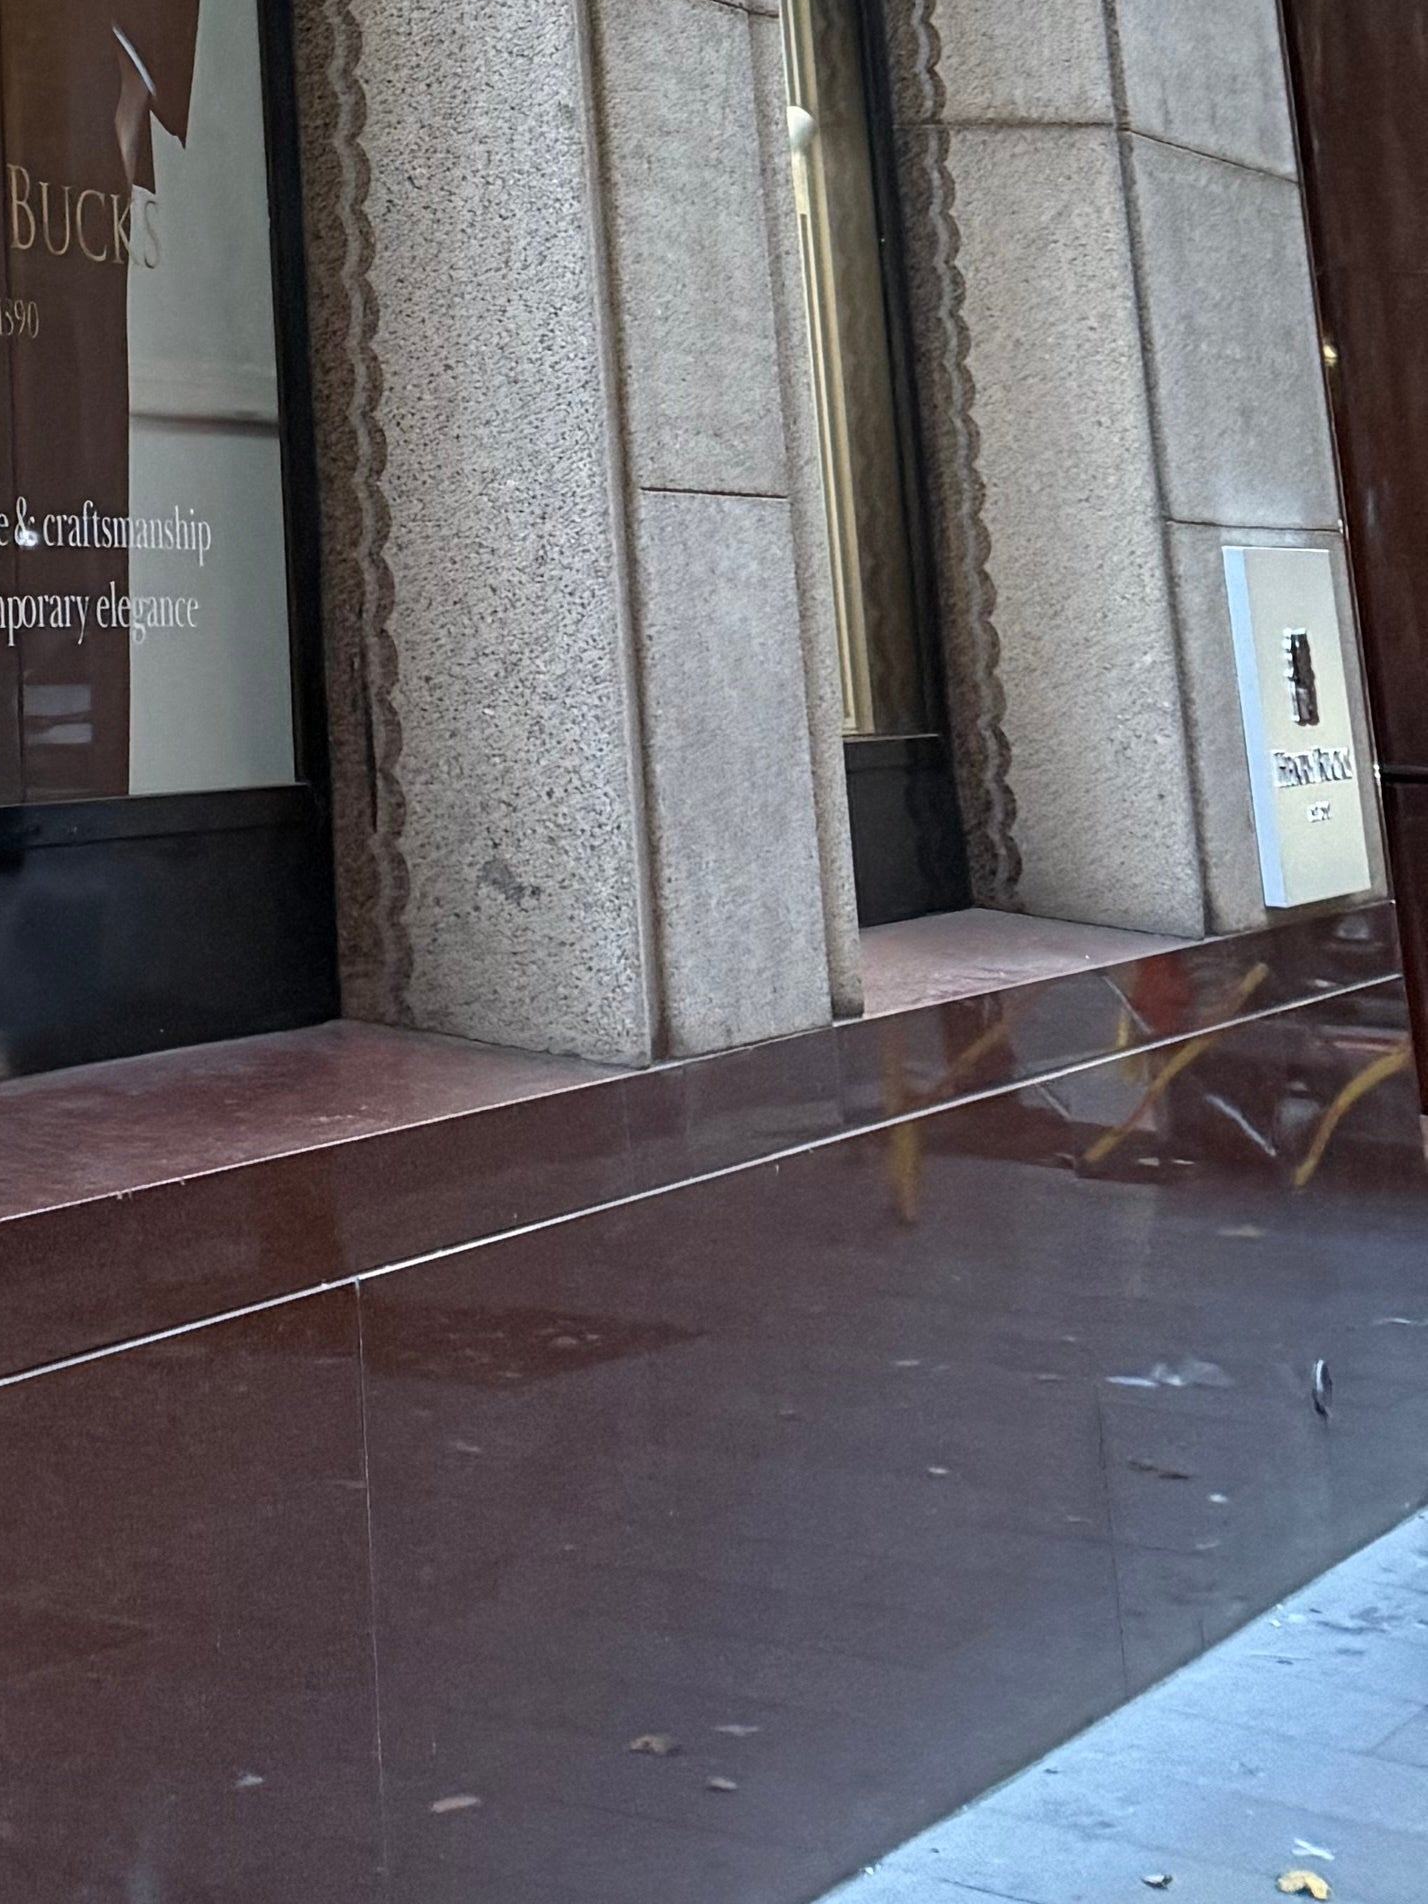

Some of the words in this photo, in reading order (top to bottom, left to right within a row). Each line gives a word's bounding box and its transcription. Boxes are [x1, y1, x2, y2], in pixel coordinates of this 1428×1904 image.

[7, 163, 161, 270] BUCKS
[42, 499, 212, 567] craftsmanship
[95, 580, 200, 644] elegance
